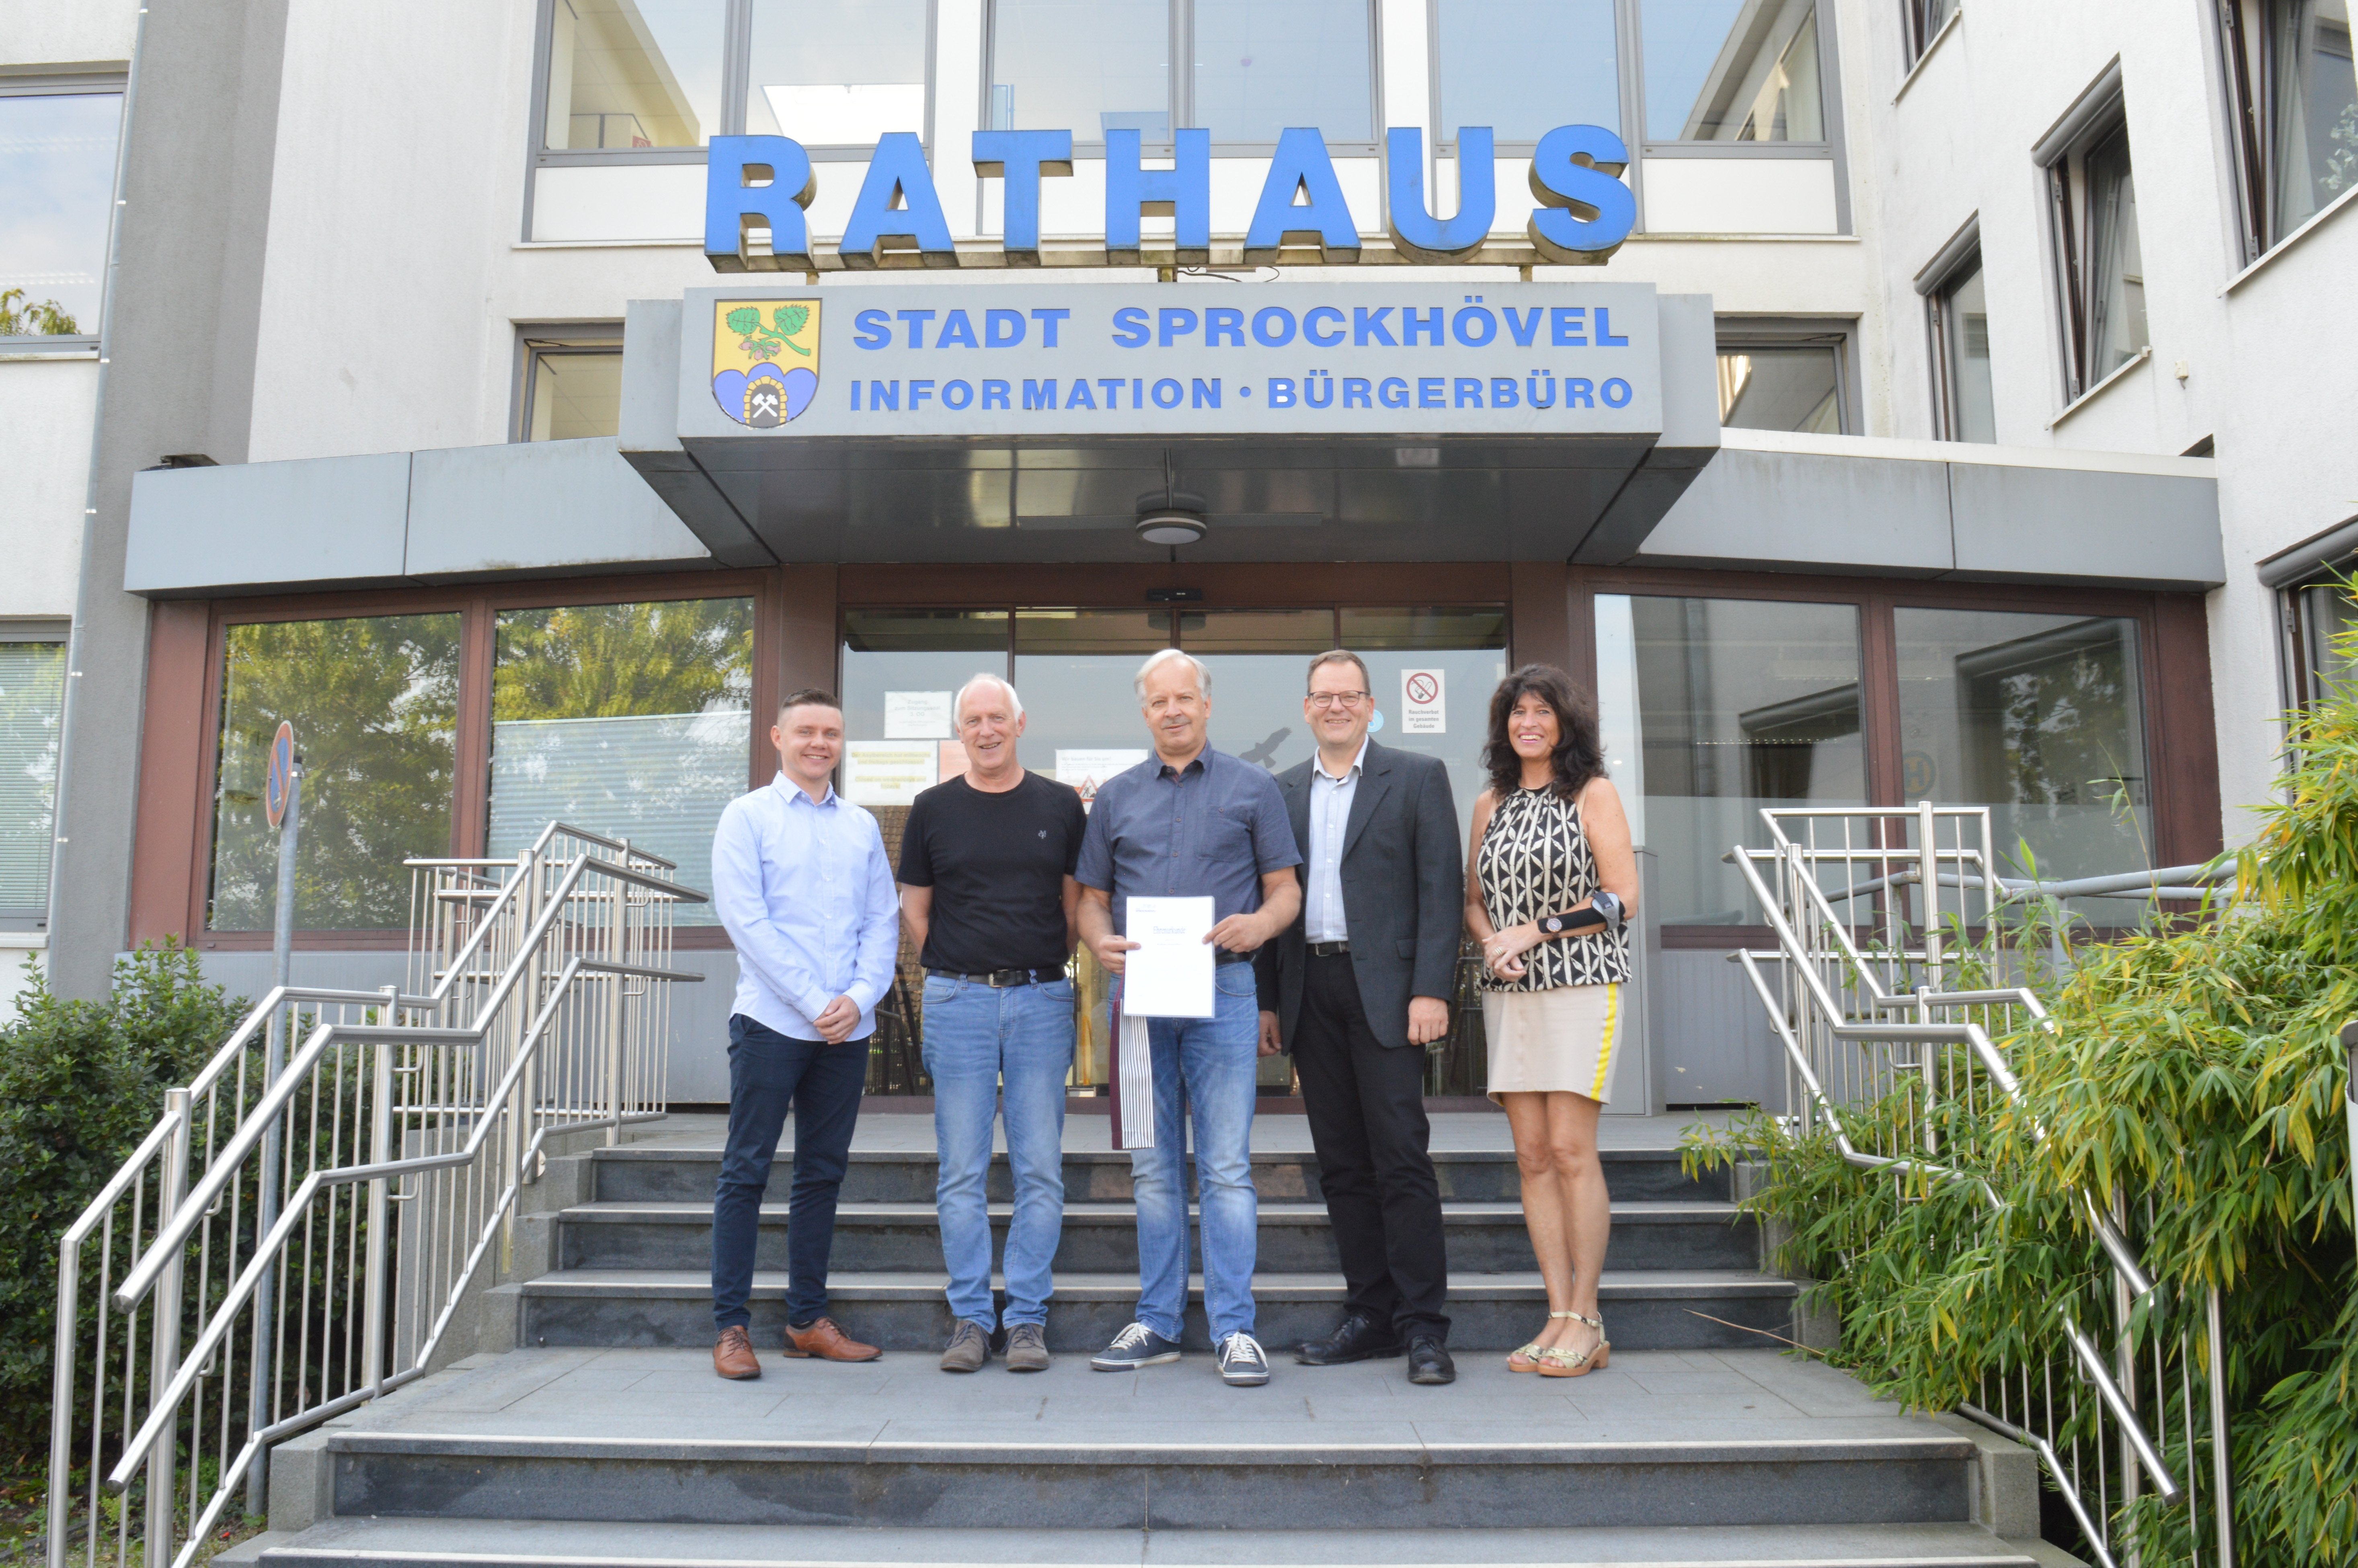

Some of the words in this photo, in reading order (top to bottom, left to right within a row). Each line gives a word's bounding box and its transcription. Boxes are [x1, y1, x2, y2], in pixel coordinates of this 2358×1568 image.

[704, 124, 1637, 261] RATHAUS
[853, 308, 1070, 350] STADT
[1112, 296, 1629, 348] SPROCKHÖVEL
[850, 378, 1221, 411] INFORMATION
[1268, 369, 1633, 409] BÜRGERBÜRO
